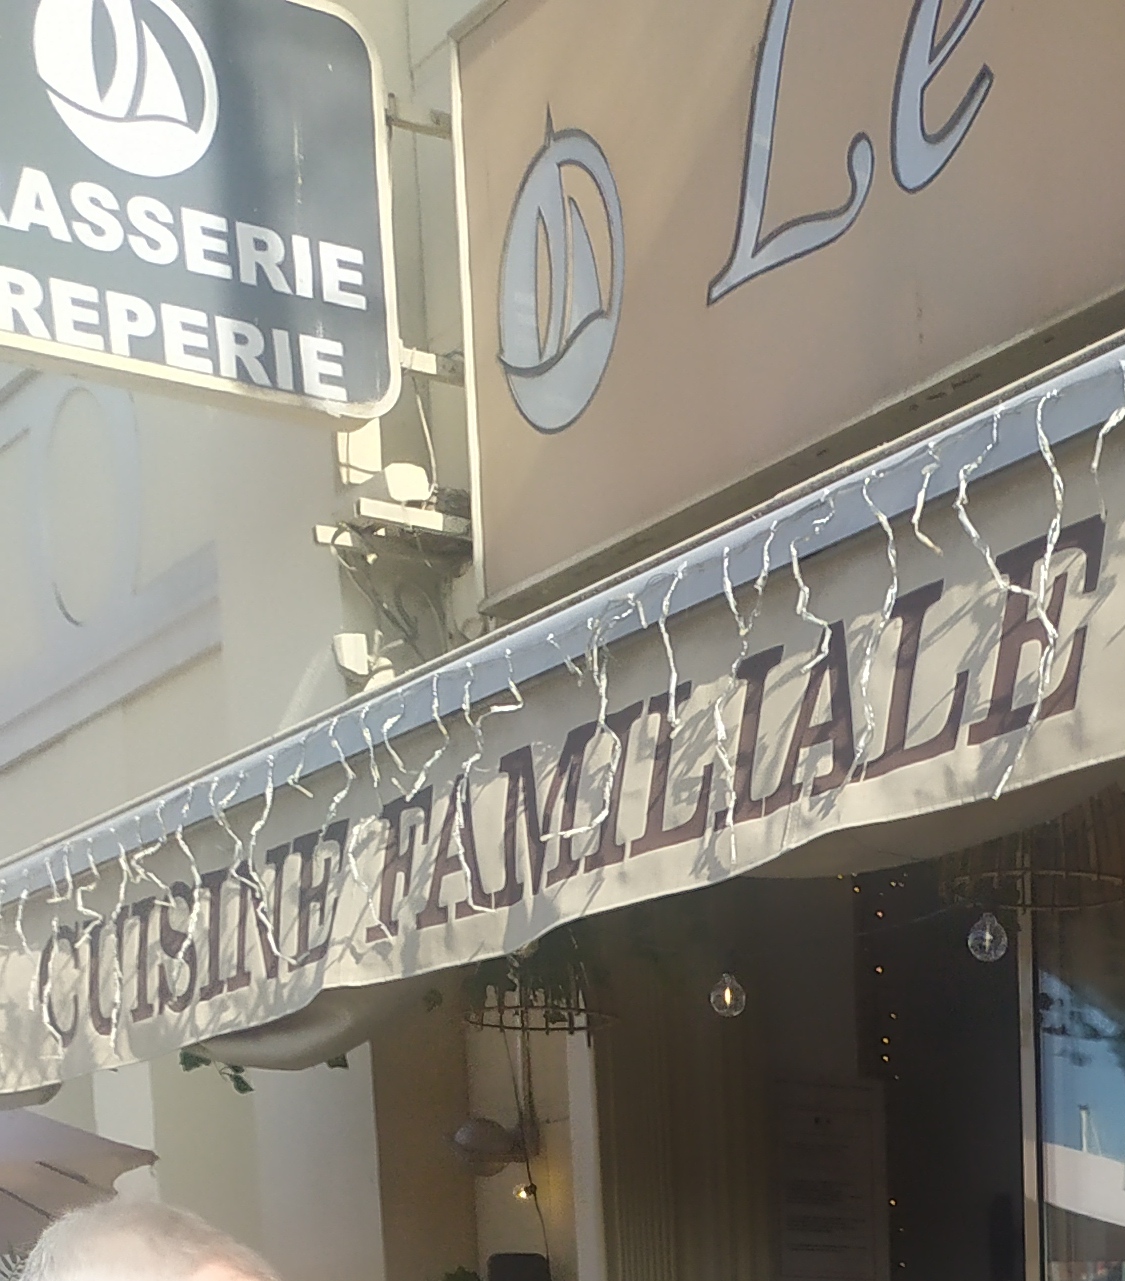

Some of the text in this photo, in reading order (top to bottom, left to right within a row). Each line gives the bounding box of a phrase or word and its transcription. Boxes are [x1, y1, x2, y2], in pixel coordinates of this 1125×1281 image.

[0, 165, 368, 311] ASSERIE
[38, 818, 350, 1049] CUISINE
[366, 514, 1106, 944] FAMILIALE
